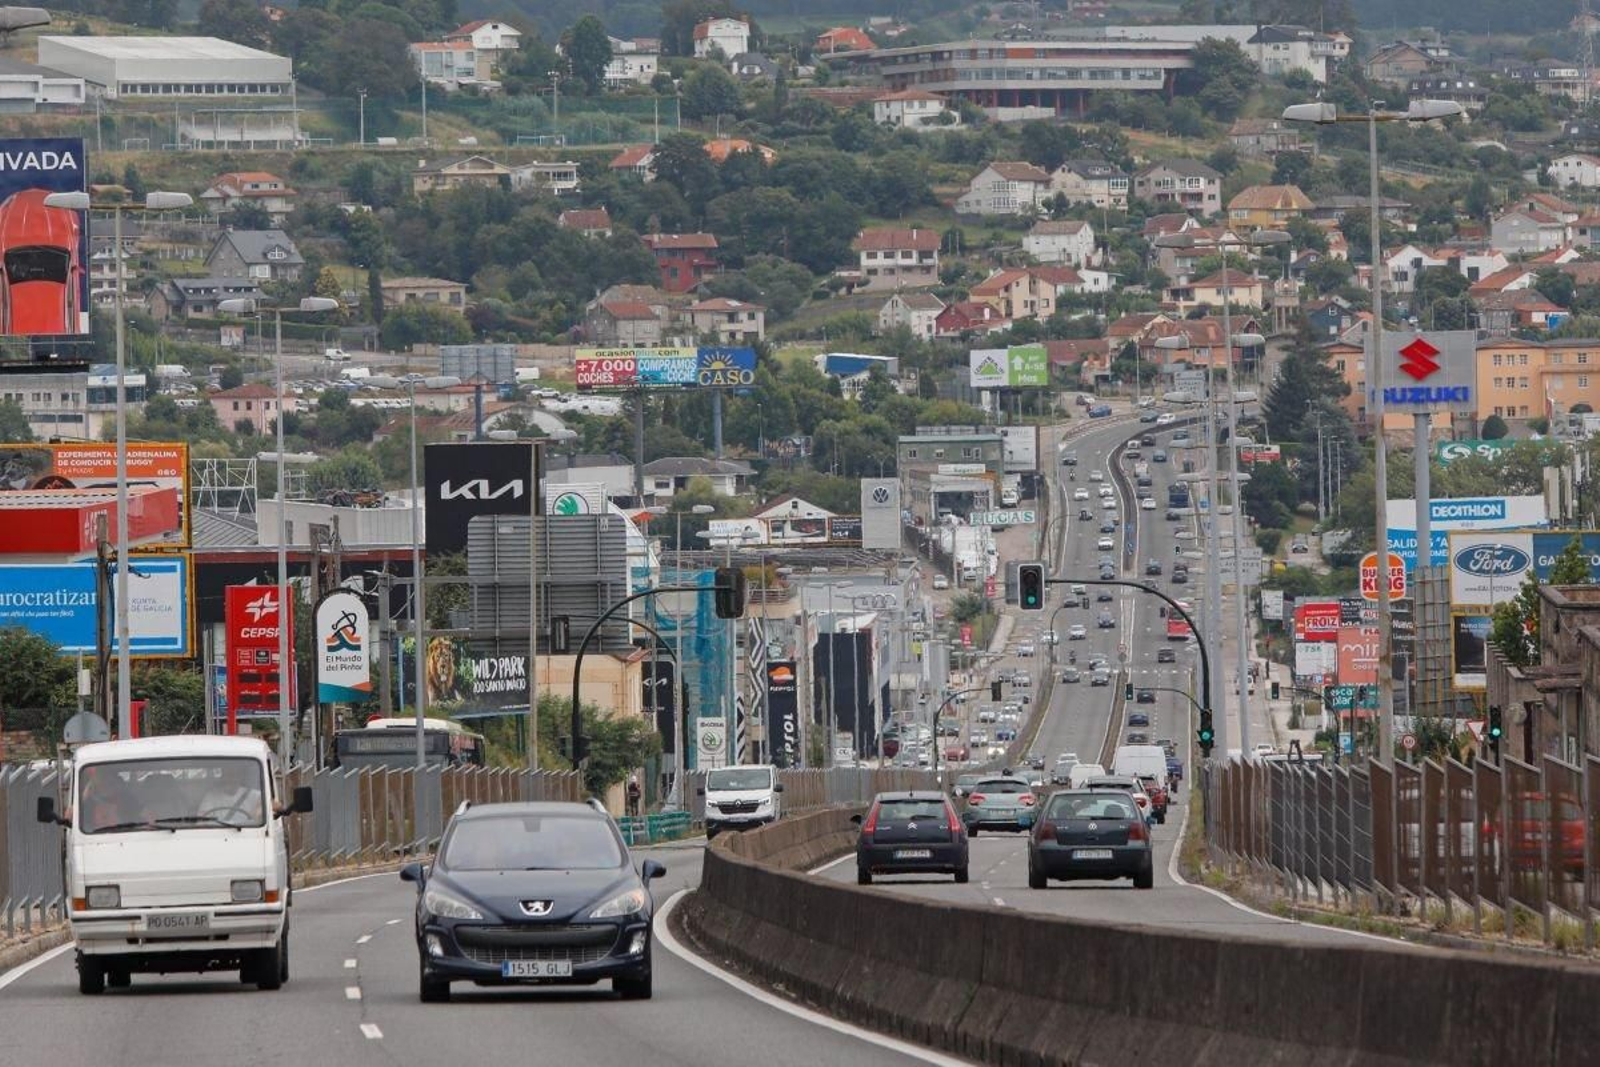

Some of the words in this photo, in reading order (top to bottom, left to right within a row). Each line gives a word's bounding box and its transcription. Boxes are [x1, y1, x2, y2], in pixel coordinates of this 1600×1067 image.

[578, 359, 635, 372] +7.000
[637, 359, 697, 371] COMPRAMOS
[577, 371, 614, 384] COCHES
[667, 369, 696, 382] COCHE
[57, 451, 113, 459] EXPERIMENTA
[1431, 504, 1502, 518] DECATHLON
[1469, 549, 1515, 571] Ford
[1306, 616, 1338, 627] FROIZ
[325, 655, 334, 663] El
[335, 654, 362, 663] Mundo
[325, 663, 338, 671] del
[499, 655, 525, 678] PARK
[512, 963, 540, 975] 1515
[546, 963, 570, 975] GLJ
